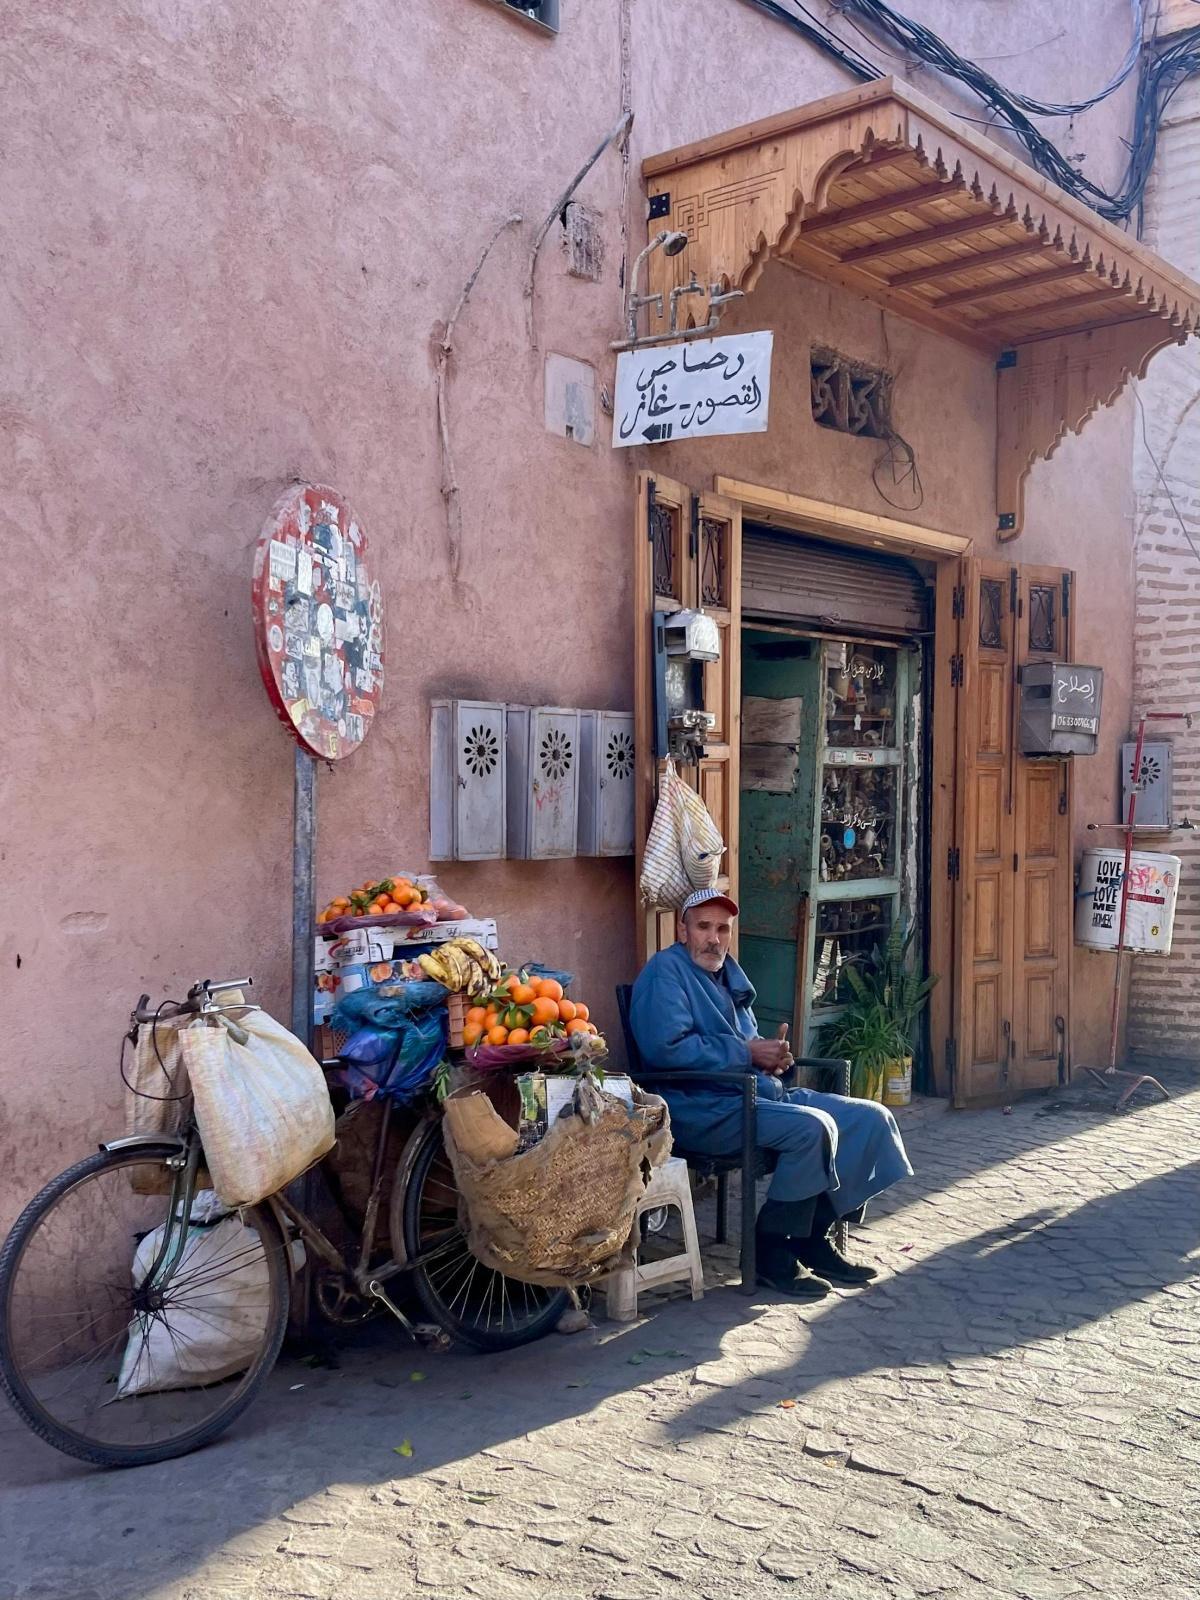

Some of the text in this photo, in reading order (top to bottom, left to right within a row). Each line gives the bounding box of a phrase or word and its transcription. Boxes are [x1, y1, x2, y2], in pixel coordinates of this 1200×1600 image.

[636, 348, 744, 391] رصاص
[1098, 860, 1122, 877] LOVE
[1096, 876, 1120, 886] ME
[1094, 886, 1118, 904] LOVE
[1092, 902, 1117, 912] ME
